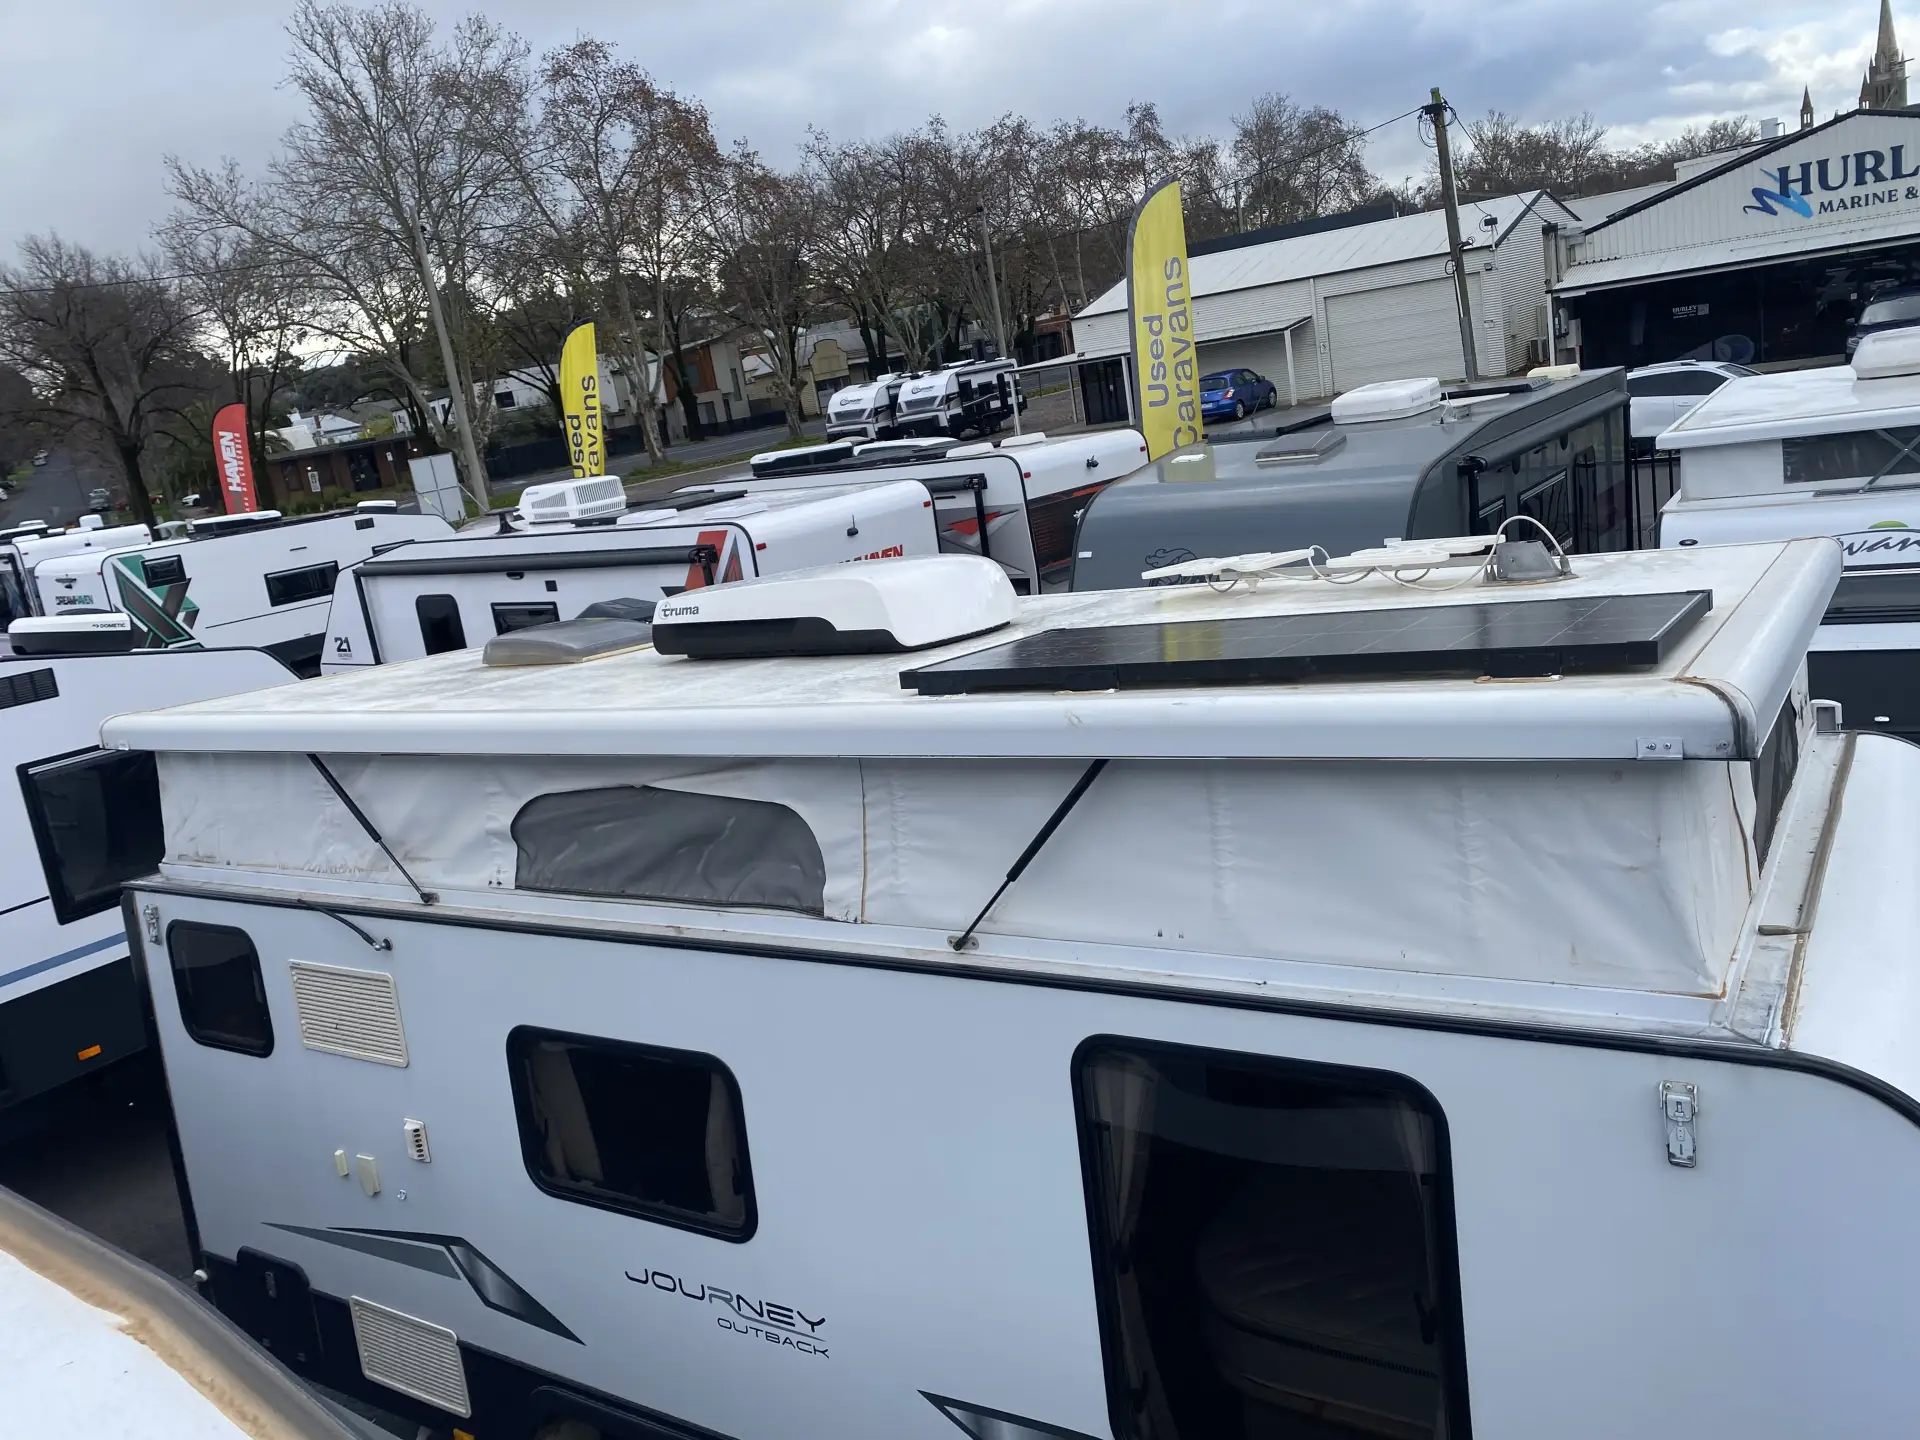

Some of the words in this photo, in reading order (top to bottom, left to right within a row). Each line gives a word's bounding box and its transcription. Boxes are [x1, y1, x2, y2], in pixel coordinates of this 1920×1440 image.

[1776, 144, 1920, 198] HURL
[1818, 188, 1899, 214] MARINE
[1904, 186, 1920, 200] &
[1142, 313, 1170, 408] Used
[1164, 255, 1199, 450] Caravans
[217, 430, 242, 492] HAVEN
[660, 604, 699, 617] truma
[333, 636, 352, 653] 21
[624, 1268, 827, 1336] JOURNEY
[716, 1317, 830, 1360] OUTBACK
